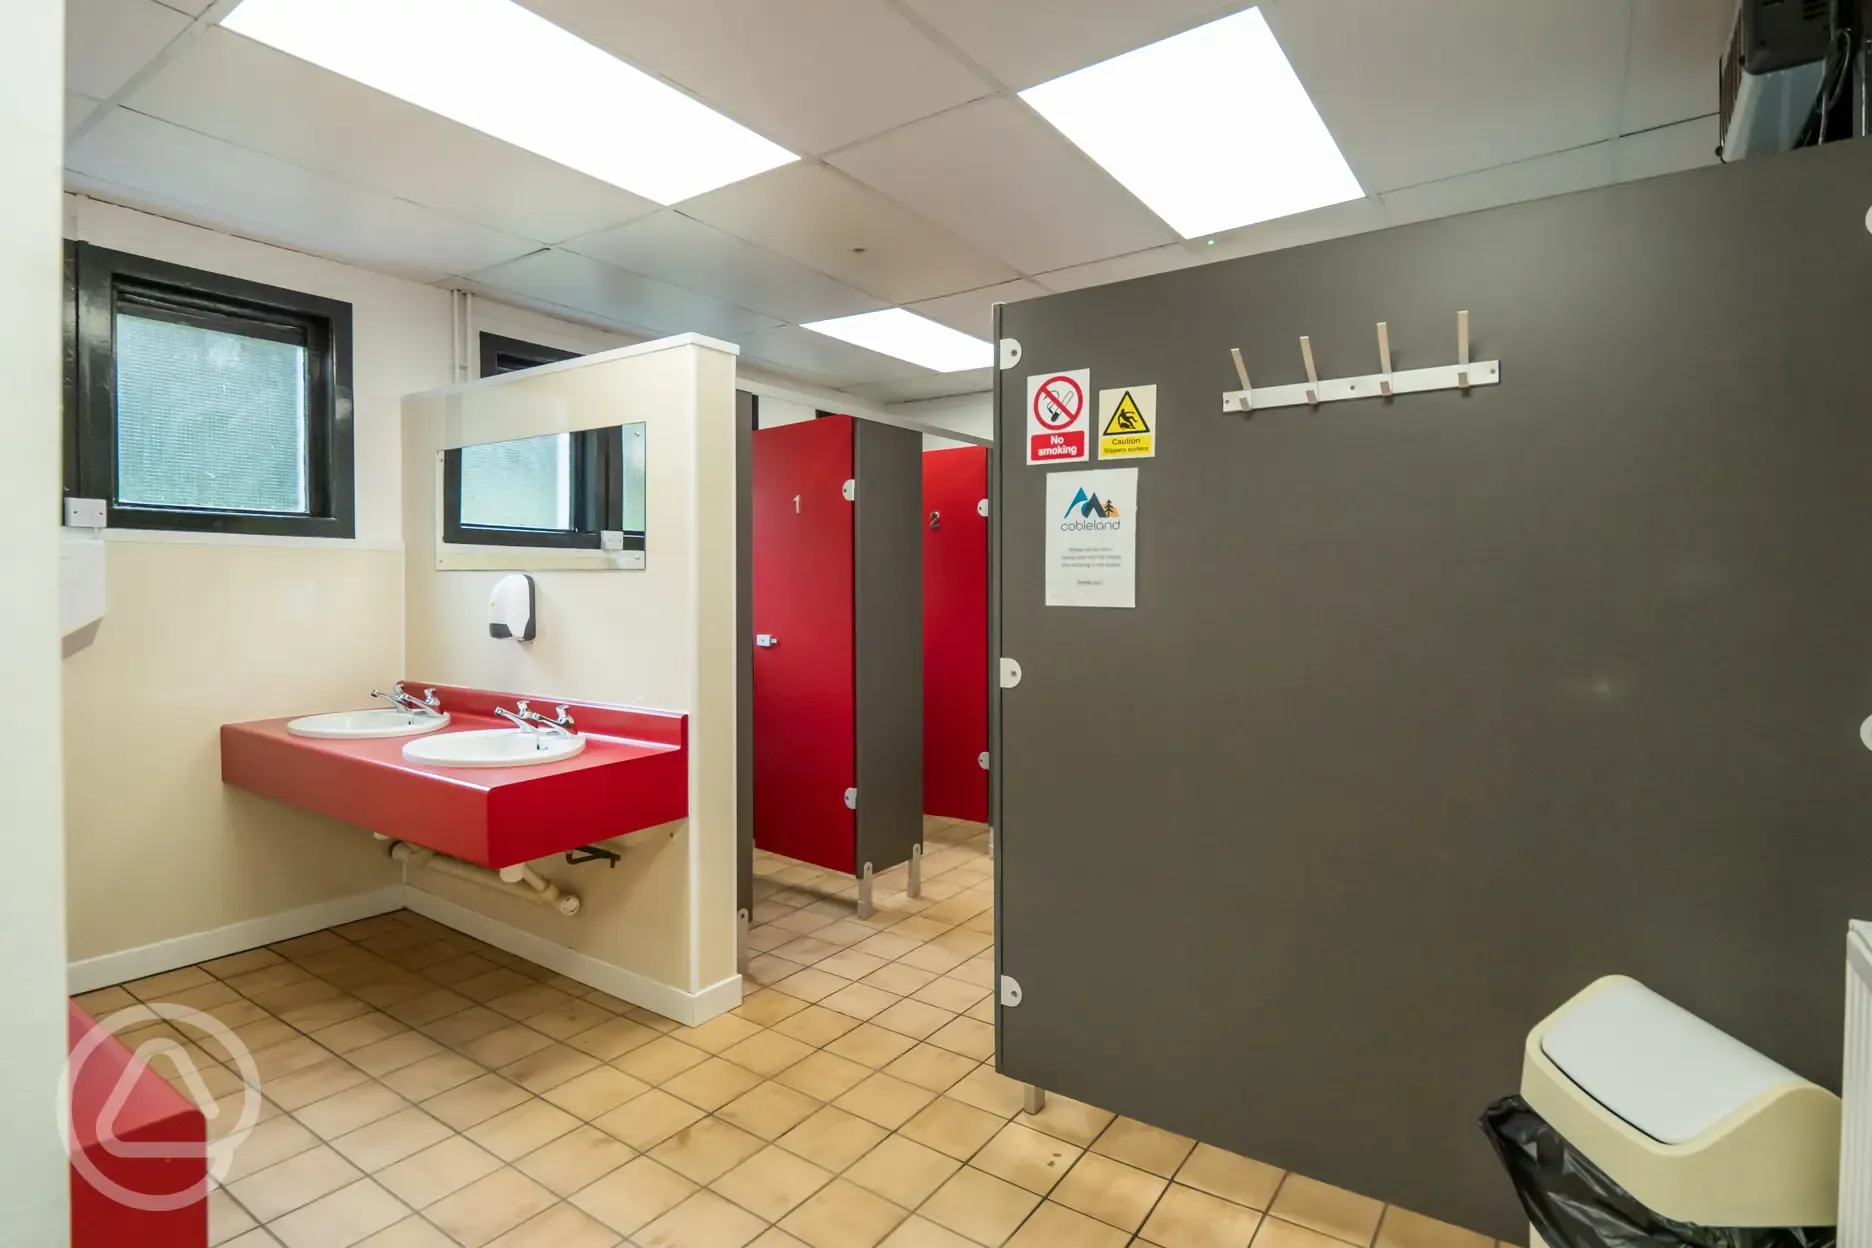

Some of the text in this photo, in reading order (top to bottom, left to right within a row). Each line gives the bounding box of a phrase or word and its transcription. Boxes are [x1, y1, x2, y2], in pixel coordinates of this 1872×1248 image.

[1050, 435, 1064, 445] No
[1112, 437, 1141, 446] Caution
[1038, 445, 1077, 457] smoking
[792, 494, 801, 514] 1
[929, 511, 940, 529] 2
[1060, 519, 1121, 532] cobleland
